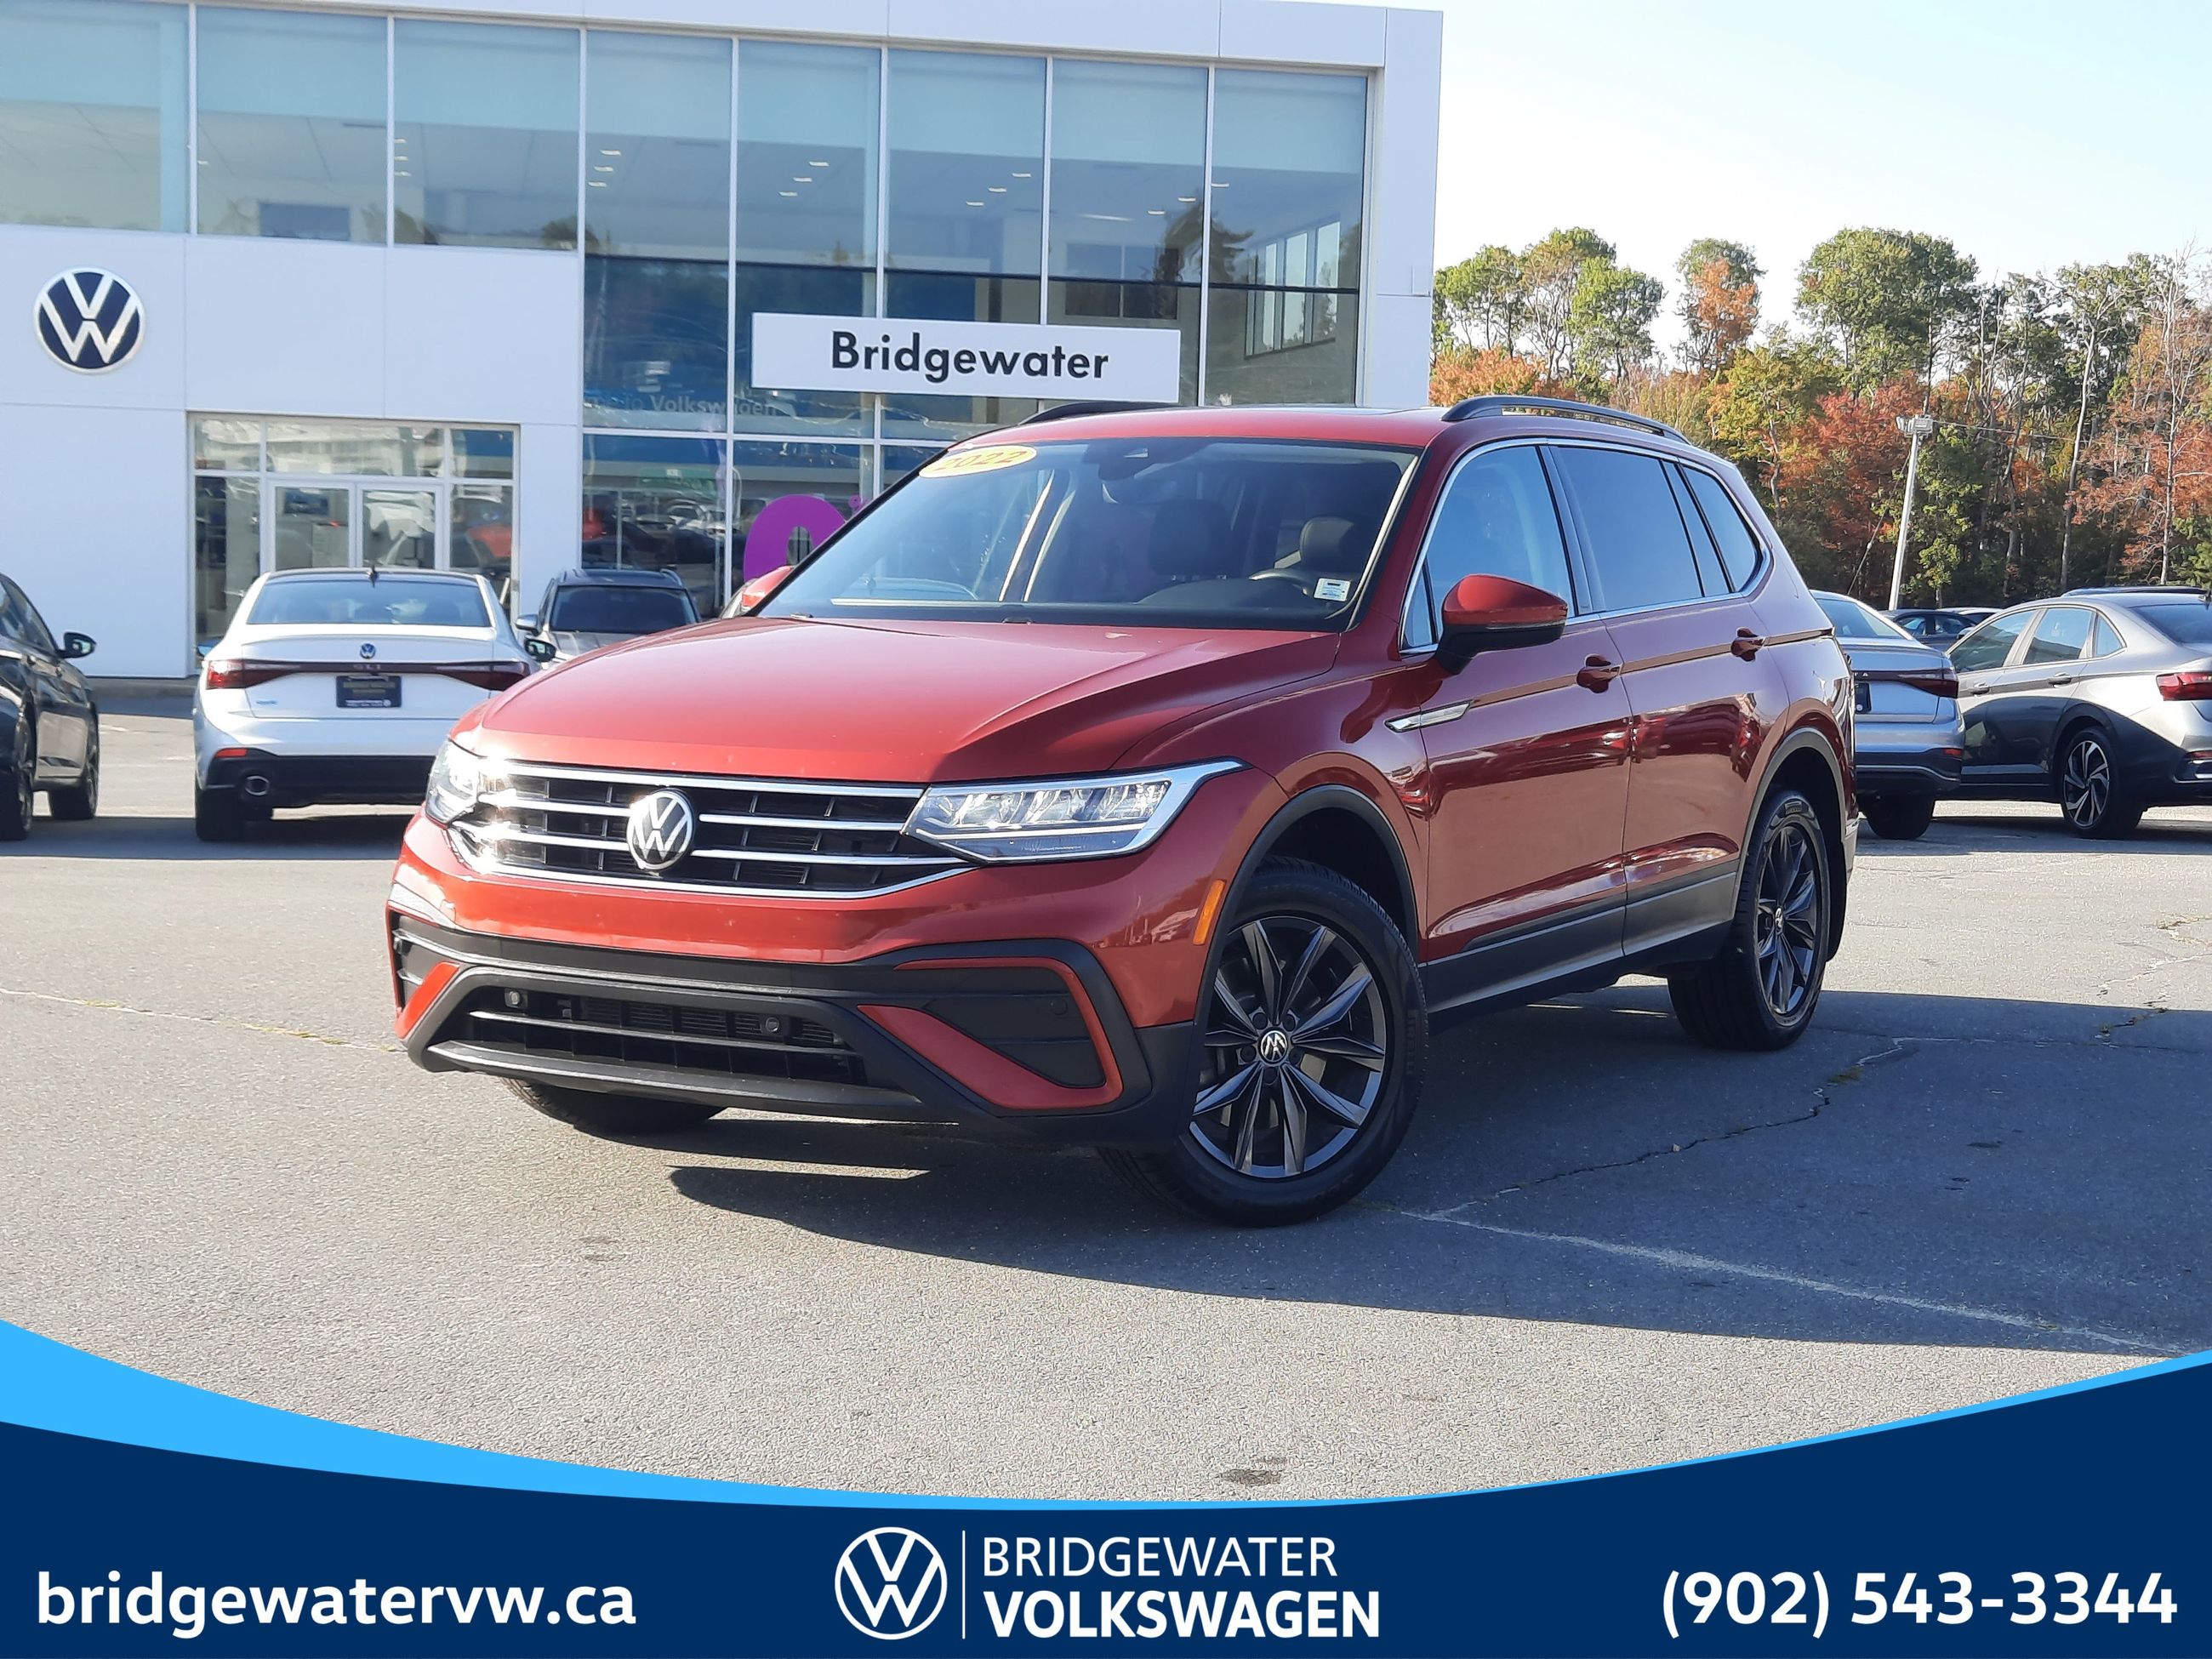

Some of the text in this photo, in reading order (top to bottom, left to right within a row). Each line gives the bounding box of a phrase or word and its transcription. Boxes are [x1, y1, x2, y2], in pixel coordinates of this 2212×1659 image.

[37, 270, 142, 371] VW
[832, 331, 1109, 384] Bridgewater
[934, 450, 1028, 471] 2022
[629, 790, 692, 869] VW
